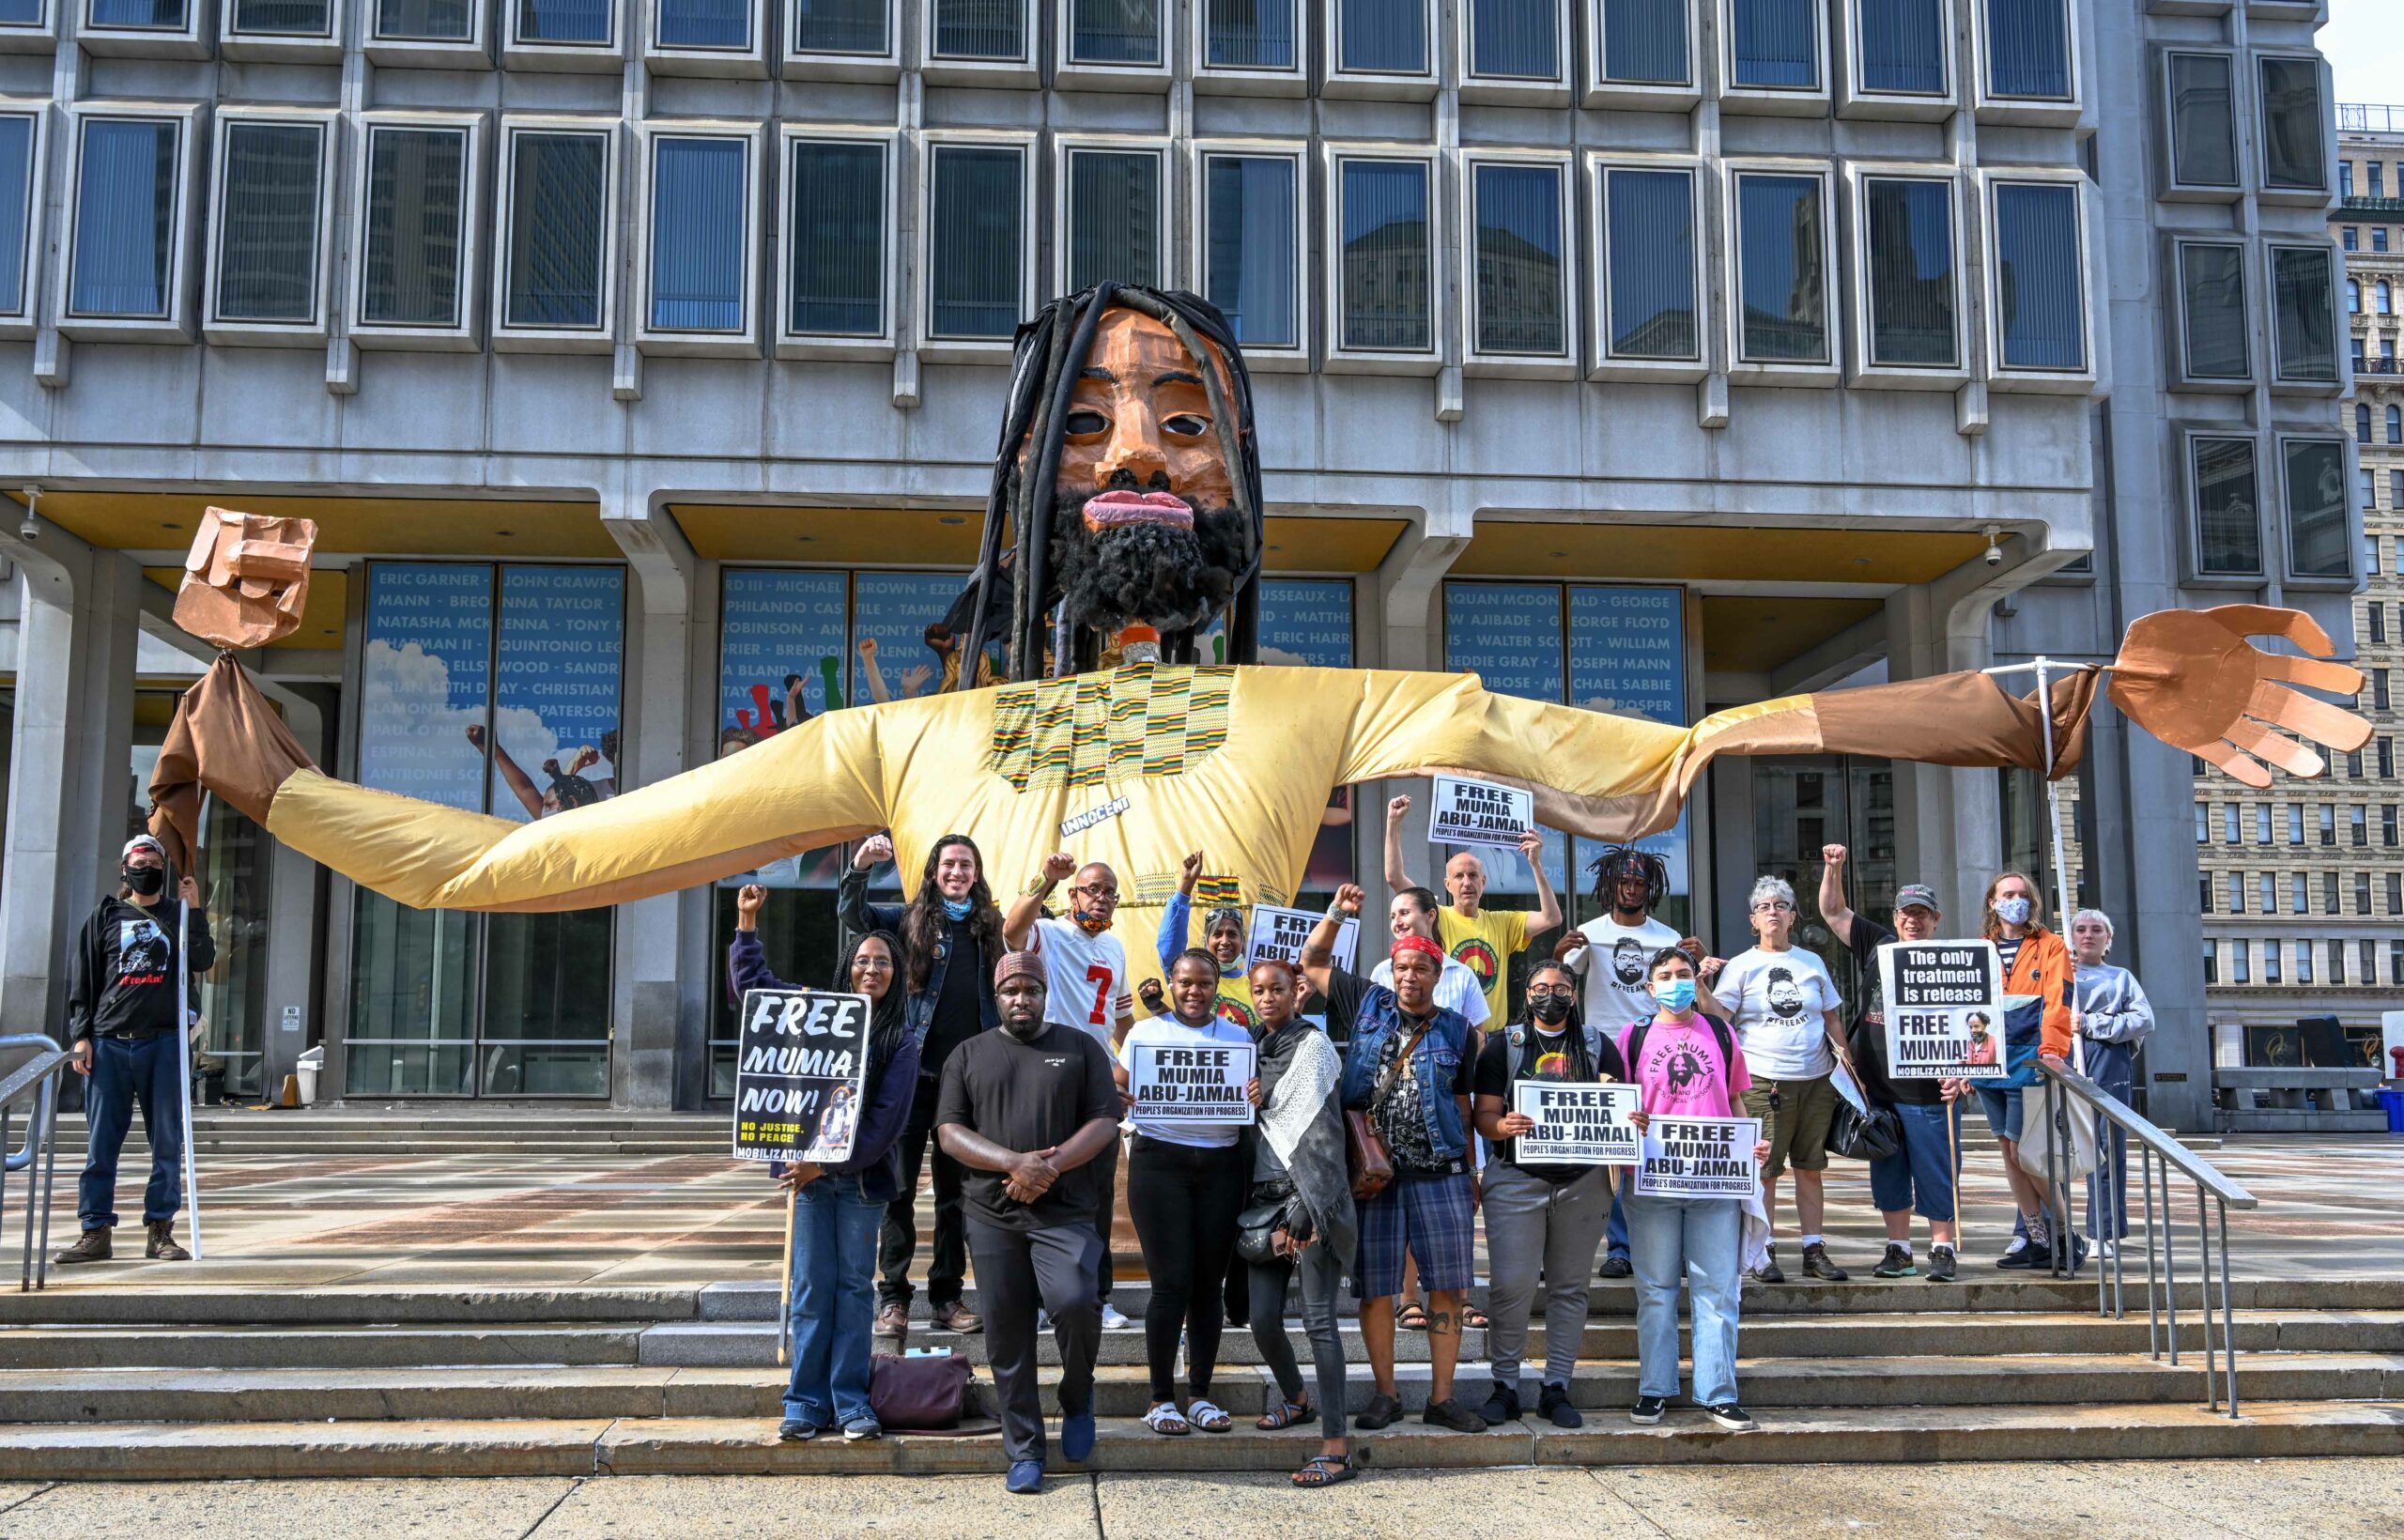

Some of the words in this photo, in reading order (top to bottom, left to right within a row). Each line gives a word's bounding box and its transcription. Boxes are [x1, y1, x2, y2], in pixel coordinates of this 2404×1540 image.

[379, 573, 411, 585] ERIC
[416, 573, 479, 586] GARNER
[503, 575, 548, 588] JOHN
[776, 580, 841, 593] MICHAEL
[856, 582, 917, 594] BROWN
[378, 594, 429, 607] MANN
[546, 597, 603, 609] TAYLOR
[726, 601, 807, 613] PHILANDO
[1610, 596, 1670, 608] GEORGE
[900, 605, 947, 616] TAMIR
[378, 616, 451, 628] NATASHA
[565, 620, 609, 631] TONY
[1471, 614, 1531, 625] AJIBADE
[1572, 616, 1618, 628] EORGE
[1625, 617, 1670, 629] FLOYD
[1273, 632, 1303, 643] ERIC
[1476, 635, 1532, 647] WALTER
[1608, 638, 1671, 650] WILLIAM
[500, 640, 592, 652] QUINTONIO
[564, 662, 619, 674] SANDR
[1499, 656, 1538, 668] GRAY
[1623, 658, 1671, 670] MANN
[738, 665, 790, 676] BLAND
[532, 684, 615, 696] CHRISTIAN
[1574, 678, 1618, 690] CHAEL
[1622, 678, 1672, 690] SABBIE
[539, 706, 618, 717] PATERSON
[580, 727, 602, 739] LEE
[1455, 784, 1513, 805] FREE
[1456, 798, 1511, 817] MUMIA
[1061, 796, 1129, 836] INNOCENT
[1439, 811, 1526, 832] ABU-JAMAL
[1436, 827, 1456, 836] PEOPLE'S
[1457, 830, 1490, 840] ORGANIZATION
[1491, 833, 1501, 841] FOR
[1908, 950, 1936, 965] The
[1941, 950, 1974, 966] only
[1903, 969, 1981, 983] treatment
[1086, 964, 1113, 1025] 7
[1904, 987, 1919, 1002] is
[1923, 987, 1982, 1002] release
[751, 995, 862, 1038] FREE
[1900, 1015, 1949, 1035] FREE
[1901, 1040, 1968, 1061] MUMIA!
[743, 1046, 853, 1077] MUMIA
[1156, 1050, 1229, 1067] FREE
[1650, 1044, 1672, 1073] FREE
[1677, 1042, 1715, 1074] MUMIA
[1158, 1068, 1225, 1084] MUMIA
[1897, 1066, 2001, 1076] MOBILIZATION4MUMIA
[1139, 1086, 1244, 1101] ABU-JAMAL
[1540, 1091, 1615, 1107] FREE
[741, 1087, 819, 1115] NOW!
[1135, 1105, 1161, 1115] PEOPLE'S
[1163, 1106, 1203, 1116] ORGANIZATION
[1205, 1107, 1214, 1116] FOR
[1216, 1107, 1246, 1116] PROGRESS
[1544, 1108, 1612, 1124] MUMIA
[741, 1122, 756, 1132] NO
[1525, 1125, 1634, 1142] ABU-JAMAL
[1662, 1124, 1735, 1142] FREE
[741, 1132, 755, 1141] NO
[760, 1132, 794, 1143] PEACE!
[1523, 1146, 1549, 1154] PEOPLE'S
[1550, 1146, 1591, 1155] ORGANIZATION
[1593, 1147, 1604, 1155] FOR
[1605, 1147, 1636, 1156] PROGRESS
[1664, 1142, 1731, 1159] MUMIA
[1644, 1158, 1749, 1177] ABU-JAMAL
[1642, 1178, 1667, 1188] PEOPLE'S
[1669, 1179, 1709, 1190] ORGANIZATION
[1710, 1181, 1720, 1190] FOR
[1721, 1181, 1750, 1191] PROGRESS
